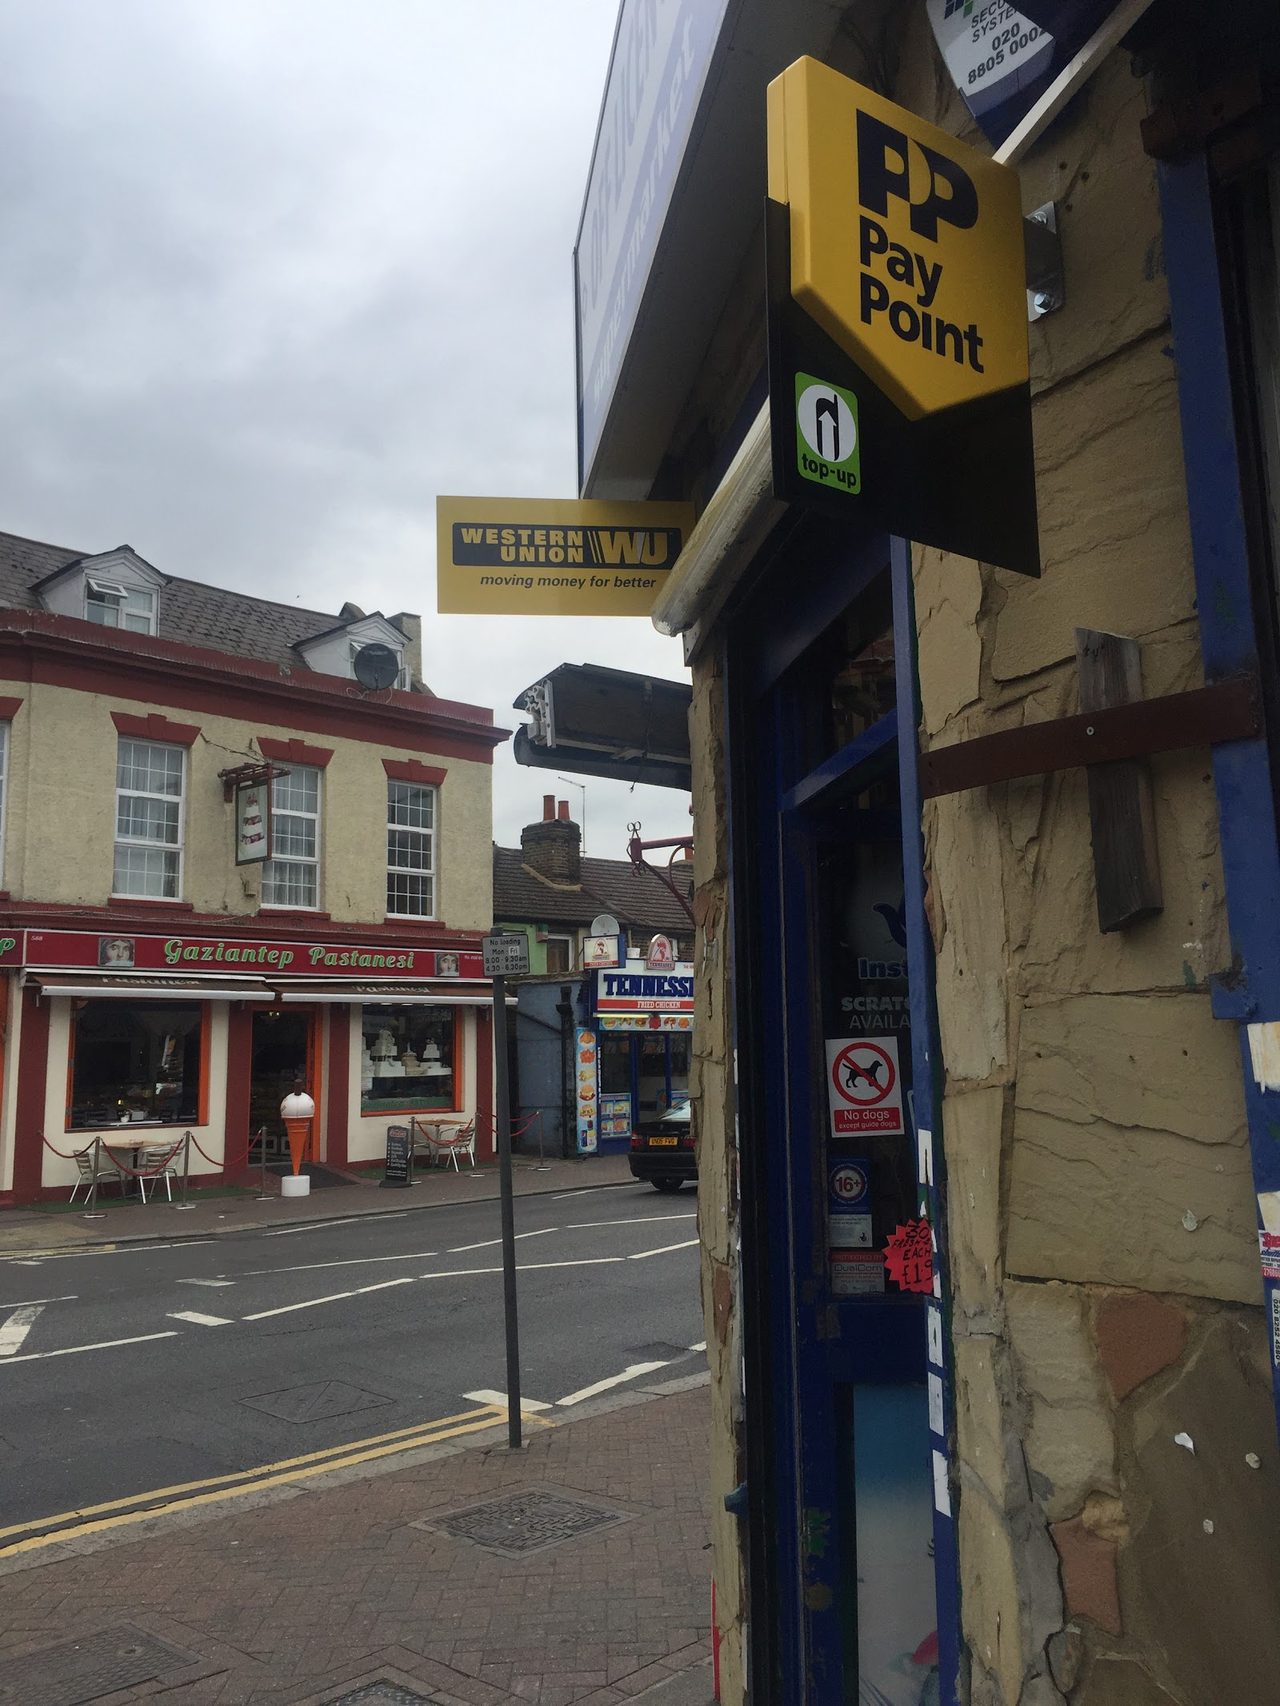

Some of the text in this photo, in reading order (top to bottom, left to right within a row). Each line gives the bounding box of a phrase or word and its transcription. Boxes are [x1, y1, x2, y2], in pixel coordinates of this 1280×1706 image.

[971, 7, 1017, 44] SYSTE
[991, 22, 1021, 52] 020
[967, 49, 1005, 85] 8805
[859, 214, 944, 308] Pay
[859, 271, 986, 375] Point
[801, 451, 859, 490] top-up
[460, 527, 668, 566] WESTERN WU
[500, 546, 584, 564] UNION
[479, 573, 657, 590] moving money for better
[164, 939, 415, 969] Gaziantep Pastanesi
[637, 1001, 681, 1009] FRIED CHICKEN
[839, 1120, 897, 1130] except guide dogs
[844, 1109, 890, 1122] No dogs
[836, 1176, 861, 1193] 16+
